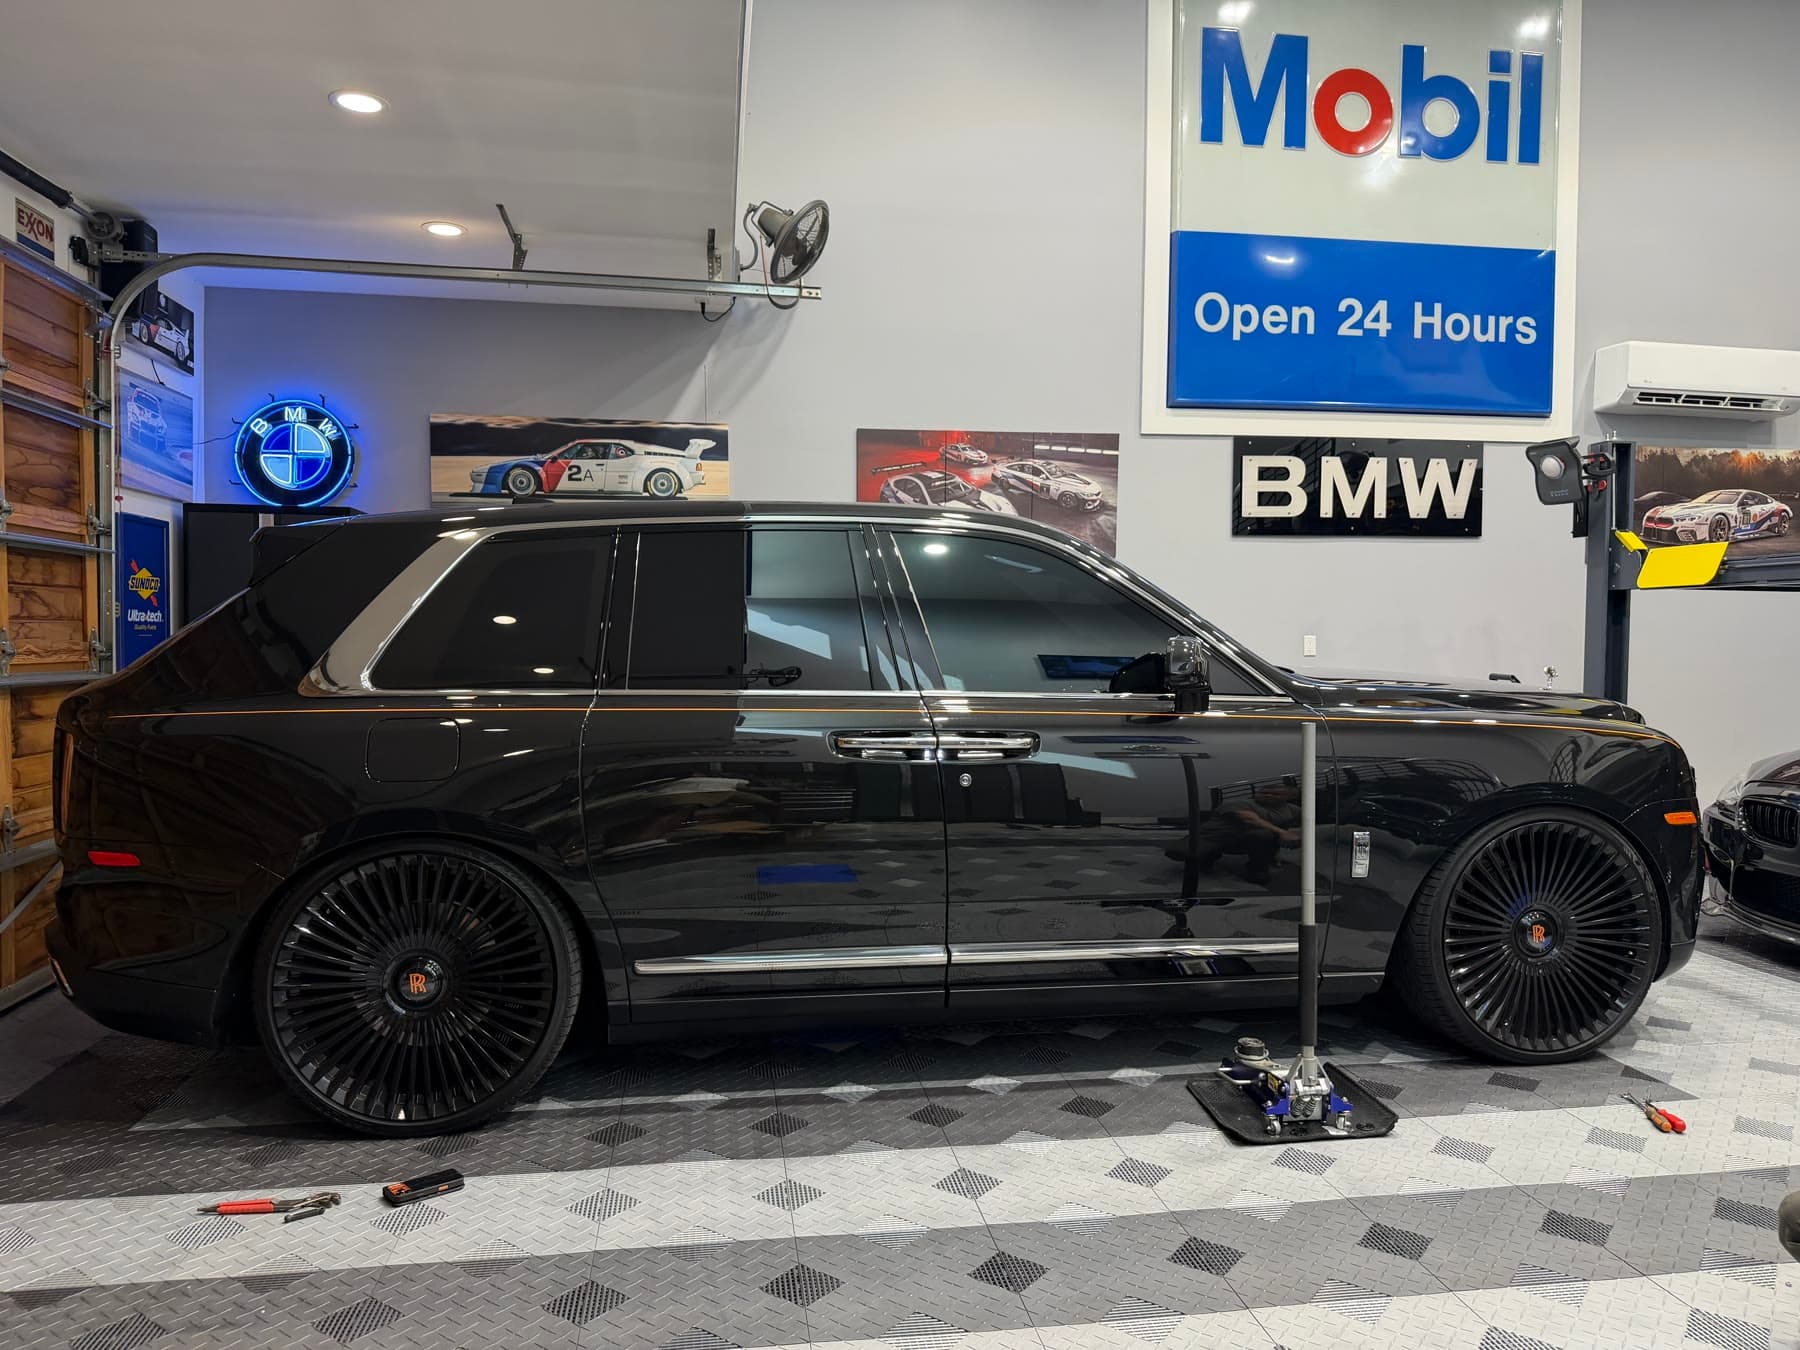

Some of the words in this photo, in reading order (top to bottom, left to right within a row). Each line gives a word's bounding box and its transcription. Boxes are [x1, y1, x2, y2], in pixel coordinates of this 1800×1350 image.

[1200, 26, 1544, 165] Mobil
[17, 207, 54, 242] EXXON
[1194, 292, 1315, 341] Open
[1337, 298, 1392, 337] 24
[1413, 302, 1537, 344] Hours
[250, 406, 342, 440] BMW
[567, 464, 594, 482] 2A
[1241, 455, 1478, 519] BMW
[129, 576, 160, 591] SUNOCO
